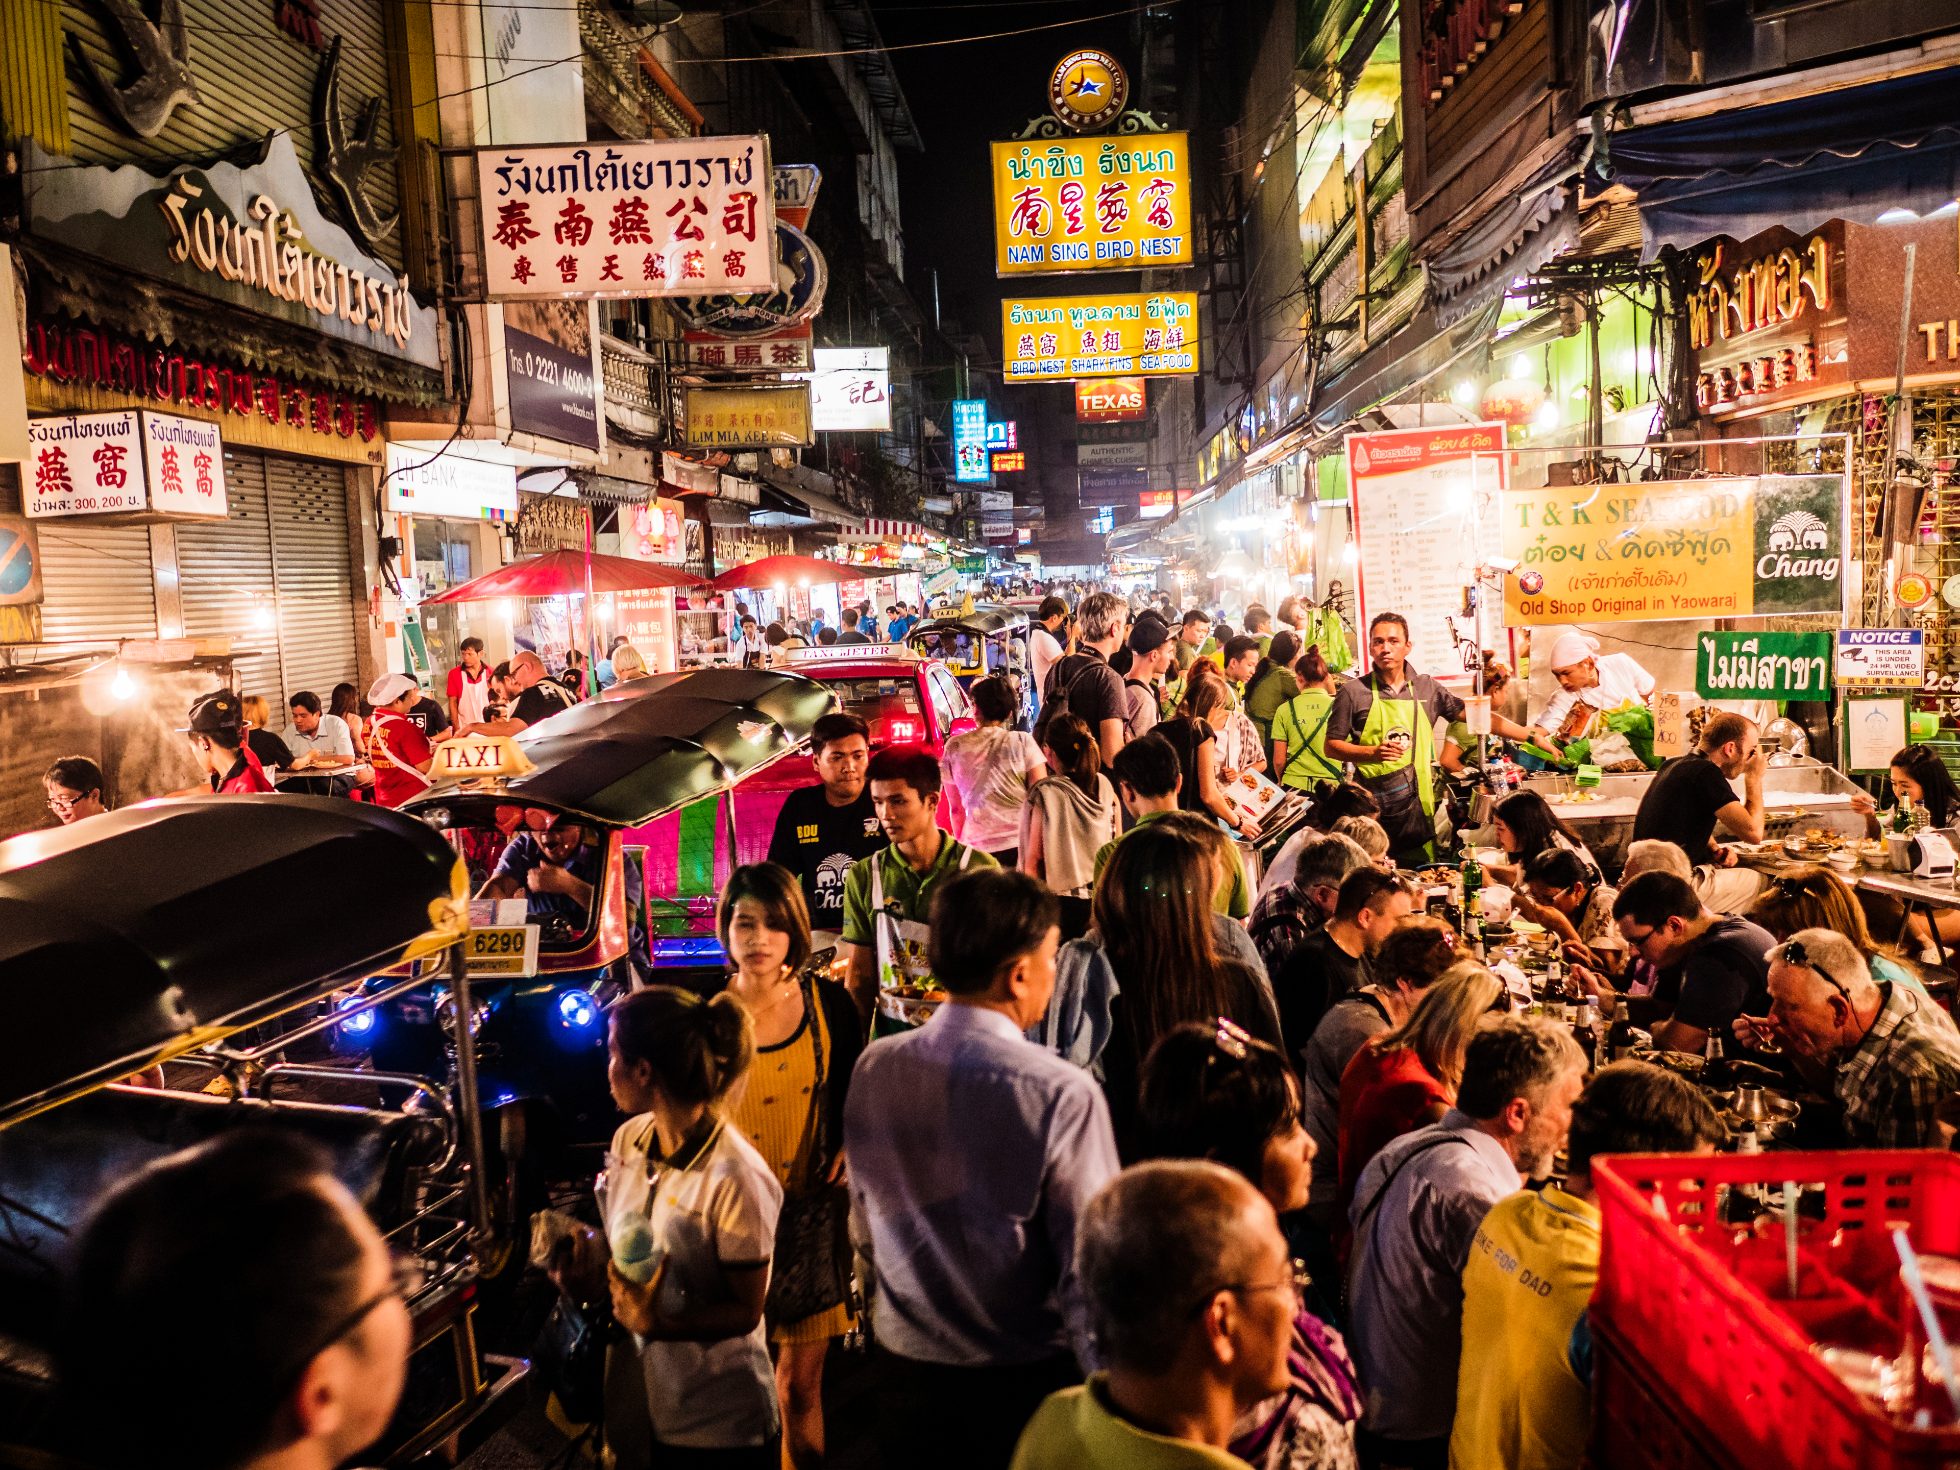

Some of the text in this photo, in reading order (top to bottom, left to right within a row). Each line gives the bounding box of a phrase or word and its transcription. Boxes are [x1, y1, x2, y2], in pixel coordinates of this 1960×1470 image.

[494, 146, 754, 197] รังนกใต้เยาวราช
[1098, 144, 1175, 175] รังนก
[492, 191, 758, 251] 泰南燕公司
[159, 174, 412, 350] รังนกใต้เยาวราช
[1008, 237, 1181, 264] NAM SING BIRD NEST
[1010, 305, 1063, 324] รังนก
[1018, 334, 1057, 357] 燕窩
[1144, 327, 1184, 350] 海鮮
[696, 344, 803, 366] 獅馬茶
[1012, 354, 1191, 375] BIRD NEST SHARK FINS SEA FOOD
[525, 352, 533, 377] 0
[536, 356, 559, 387] 2221
[562, 367, 593, 399] 4600-2
[1079, 393, 1142, 410] TEXAS
[150, 418, 216, 449] รังนกไทยแท้
[692, 431, 714, 443] LIM
[718, 430, 740, 442] MIA
[745, 430, 768, 442] KEE
[1459, 436, 1469, 448] &
[1091, 447, 1134, 455] AUTHENTIC
[36, 442, 128, 496] 燕窩
[161, 444, 213, 497] 燕窩
[421, 460, 458, 488] BANK
[102, 497, 122, 508] 200
[1515, 501, 1534, 529] T
[1543, 501, 1562, 526] &
[1572, 500, 1594, 525] K
[1595, 539, 1614, 561] &
[1520, 593, 1738, 618] Old Shop Original in Yaowaraj
[1849, 632, 1911, 643] NOTICE
[803, 646, 889, 658] TAXI METER
[1701, 636, 1826, 690] ไม่มีสาขา
[443, 744, 502, 768] TAXI
[797, 824, 818, 839] BDU
[814, 889, 844, 909] Cha
[475, 932, 524, 953] 6290
[1520, 1269, 1552, 1296] DAD
